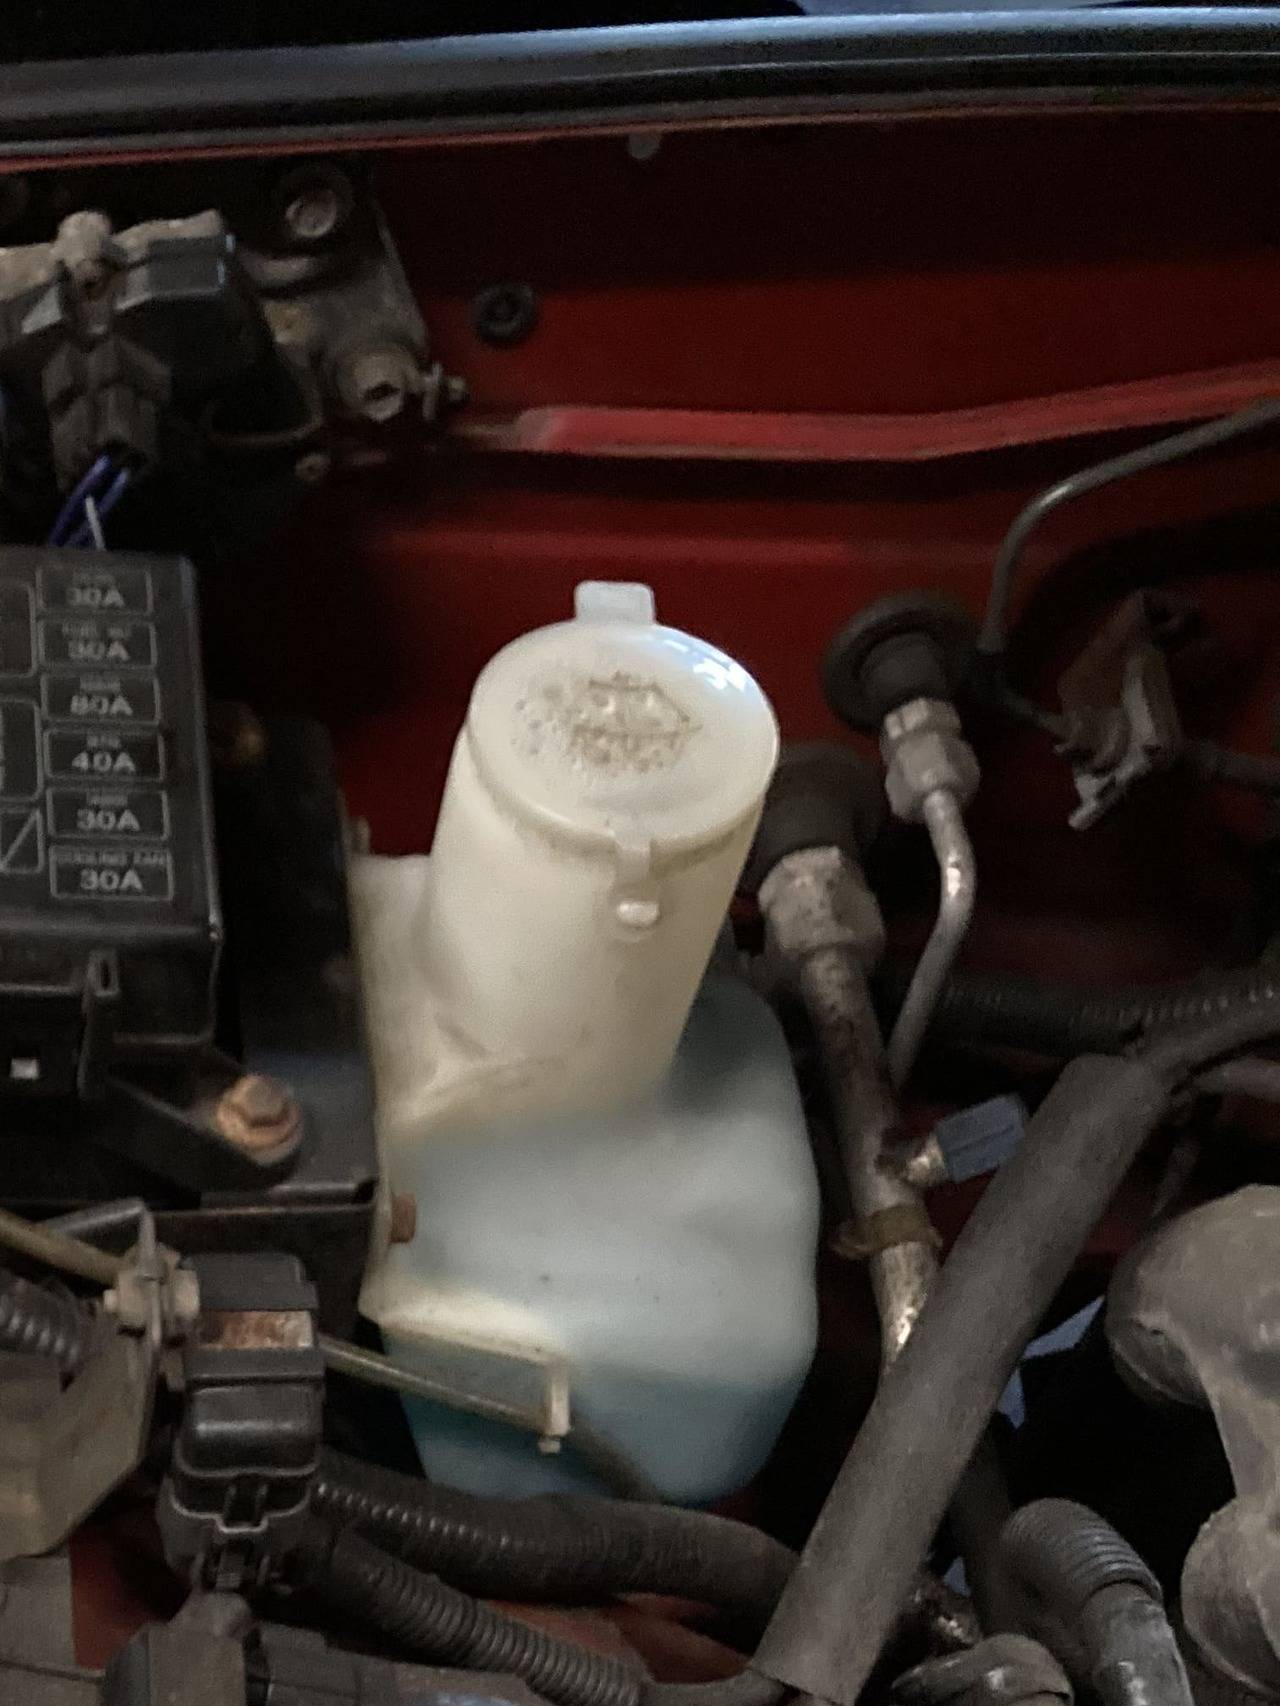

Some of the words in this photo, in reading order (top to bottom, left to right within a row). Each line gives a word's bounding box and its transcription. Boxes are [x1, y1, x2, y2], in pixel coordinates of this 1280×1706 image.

[72, 752, 137, 773] 40A
[76, 808, 141, 832] 30A
[80, 869, 144, 893] 30A
